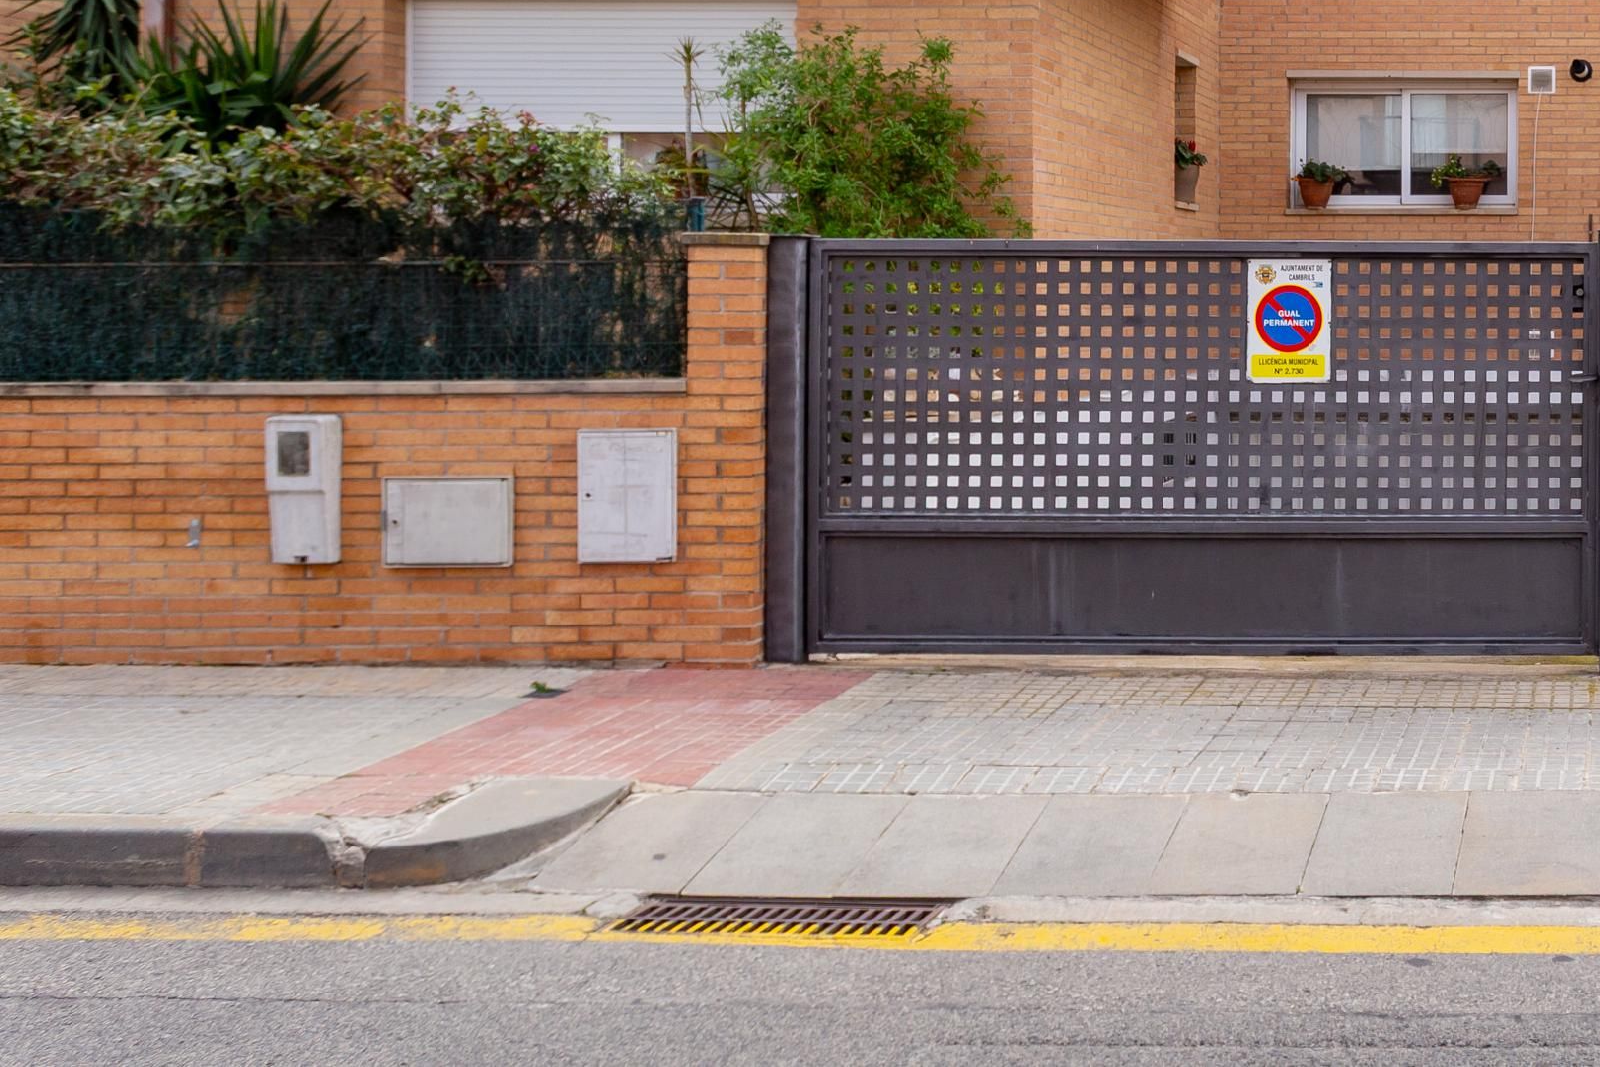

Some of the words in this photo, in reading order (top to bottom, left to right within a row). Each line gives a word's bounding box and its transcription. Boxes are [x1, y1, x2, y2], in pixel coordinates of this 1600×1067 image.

[1278, 310, 1300, 318] GUAL
[1263, 319, 1314, 327] PERMANENT
[1288, 357, 1318, 366] MUNICIPAL
[1284, 367, 1304, 375] 2.730
